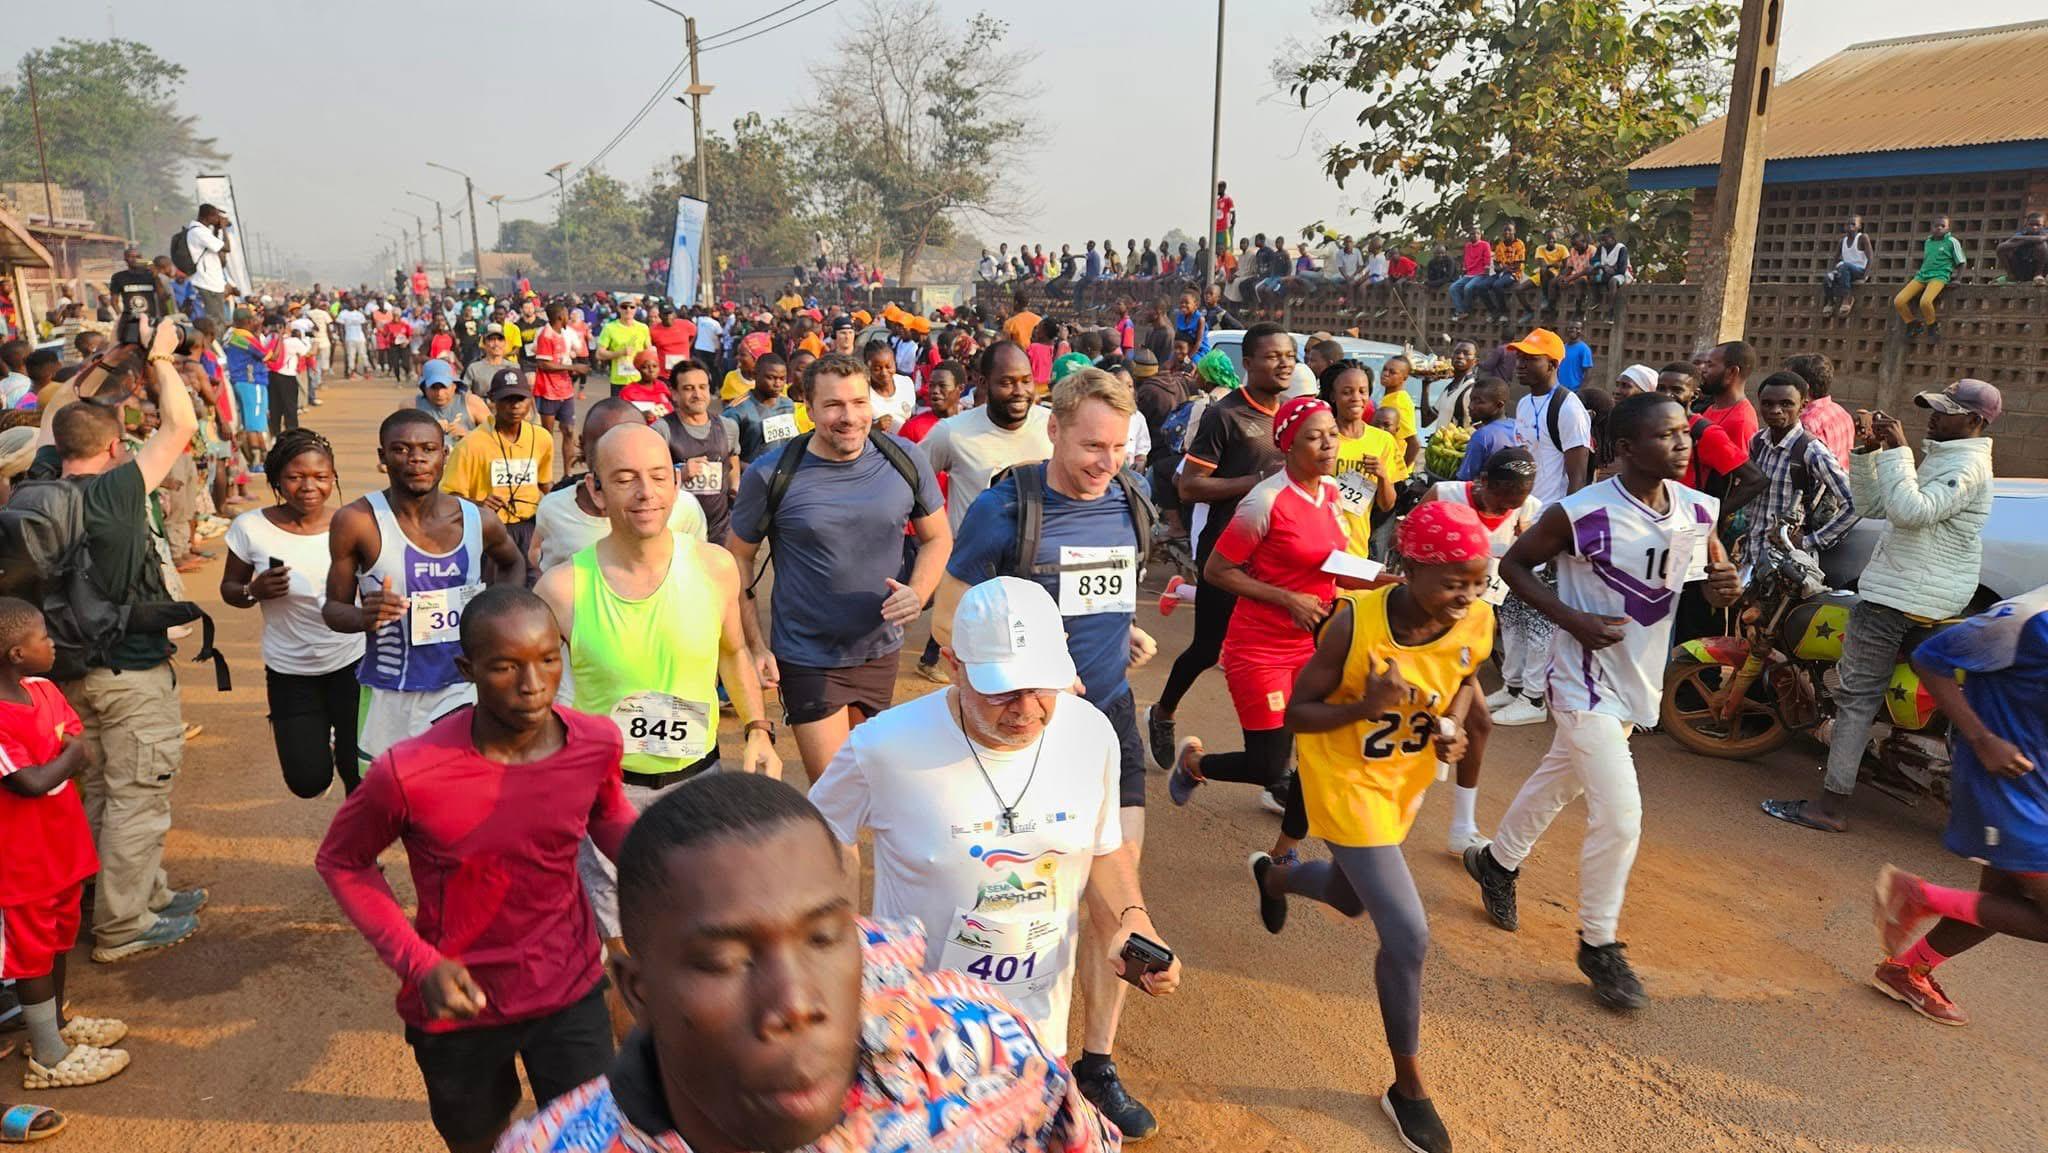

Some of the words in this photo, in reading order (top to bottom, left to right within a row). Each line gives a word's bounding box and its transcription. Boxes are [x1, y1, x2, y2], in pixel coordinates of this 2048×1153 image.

[1339, 482, 1363, 504] 732
[414, 562, 461, 578] FILA
[1078, 575, 1122, 595] 839
[630, 717, 688, 741] 845
[1363, 711, 1435, 759] 23
[967, 951, 1037, 983] 401
